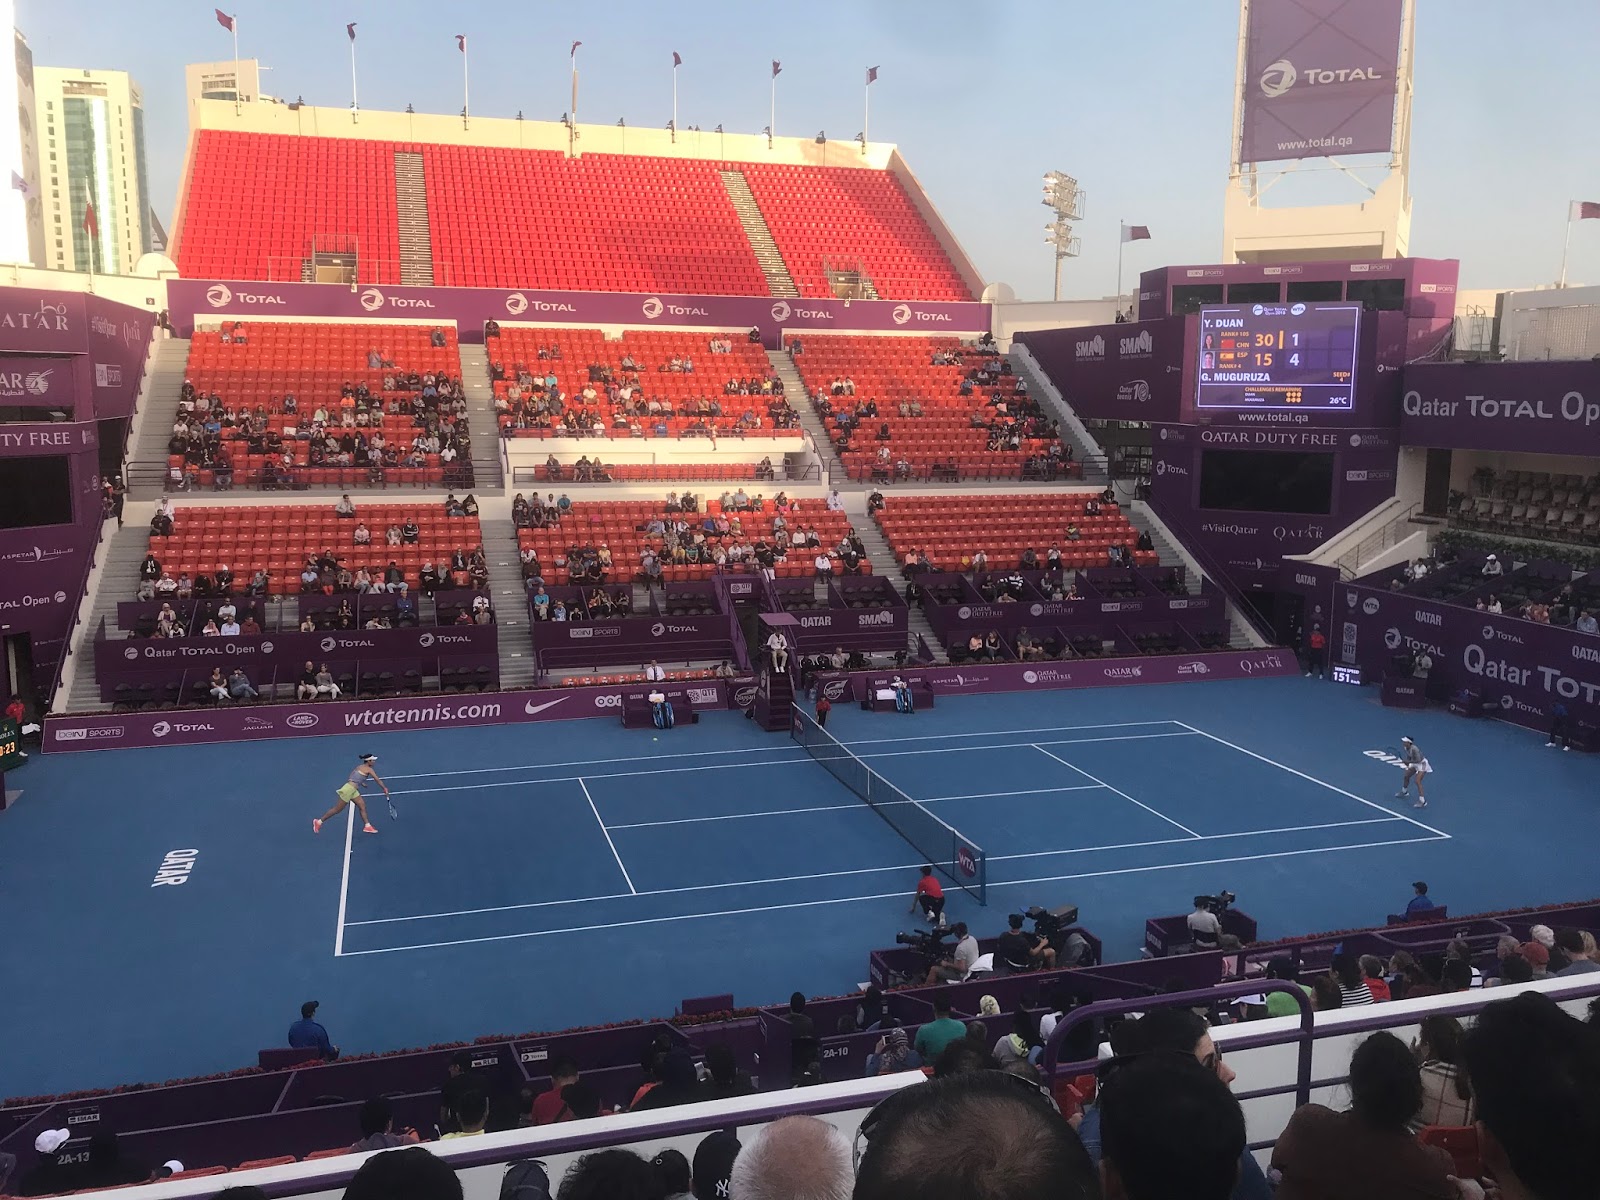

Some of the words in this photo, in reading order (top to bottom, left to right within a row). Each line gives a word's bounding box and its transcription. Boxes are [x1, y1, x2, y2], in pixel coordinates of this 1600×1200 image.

[1304, 67, 1382, 85] TOTAL
[1277, 137, 1353, 152] www.total.qa
[236, 293, 286, 304] TOTAL
[388, 297, 435, 308] TOTAL
[532, 301, 576, 312] TOTAL
[667, 305, 708, 316] TOTAL
[794, 309, 834, 319] TOTAL
[915, 312, 952, 321] TOTAL
[1204, 320, 1213, 328] Y.
[1216, 319, 1243, 328] DUAN
[1255, 334, 1274, 347] 30
[1292, 333, 1299, 346] 1
[1255, 353, 1273, 366] 15
[1290, 353, 1299, 366] 4
[1201, 373, 1212, 381] G.
[1213, 373, 1271, 382] MUGURUZA
[1403, 390, 1459, 416] Qatar
[1465, 395, 1553, 418] TOTAL
[1239, 413, 1309, 424] www.total.qa
[30, 432, 71, 446] FREE
[1201, 431, 1250, 444] QATAR
[1255, 432, 1298, 444] DUTY
[1302, 434, 1337, 445] FREE
[1168, 465, 1188, 475] TOTAL
[1202, 522, 1258, 536] #VisitQatar
[1296, 573, 1316, 587] QATAR
[22, 595, 50, 607] Open
[801, 616, 831, 628] QATAR
[1416, 610, 1443, 626] QATAR
[594, 628, 618, 636] SPORTS
[667, 625, 698, 633] TOTAL
[339, 639, 375, 647] TOTAL
[437, 635, 472, 643] TOTAL
[1496, 631, 1524, 644] TOTAL
[144, 646, 176, 658] Qatar
[179, 646, 223, 656] TOTAL
[225, 643, 255, 656] Open
[1405, 636, 1446, 657] TOTAL
[1104, 668, 1132, 677] QATAR
[1240, 658, 1283, 675] QATAR
[1333, 672, 1350, 683] 151
[1464, 643, 1531, 686] Qatar
[1537, 665, 1600, 705] TOT
[1515, 701, 1544, 716] TOTAL
[345, 703, 501, 727] wtatennis.com
[0, 730, 15, 739] OLEX
[58, 730, 84, 739] beIN
[89, 728, 121, 738] SPORTS
[174, 724, 214, 733] TOTAL
[151, 849, 199, 887] QATAR
[959, 852, 975, 873] WTA
[824, 1047, 848, 1058] 2A-10
[57, 1152, 90, 1165] 2A-13
